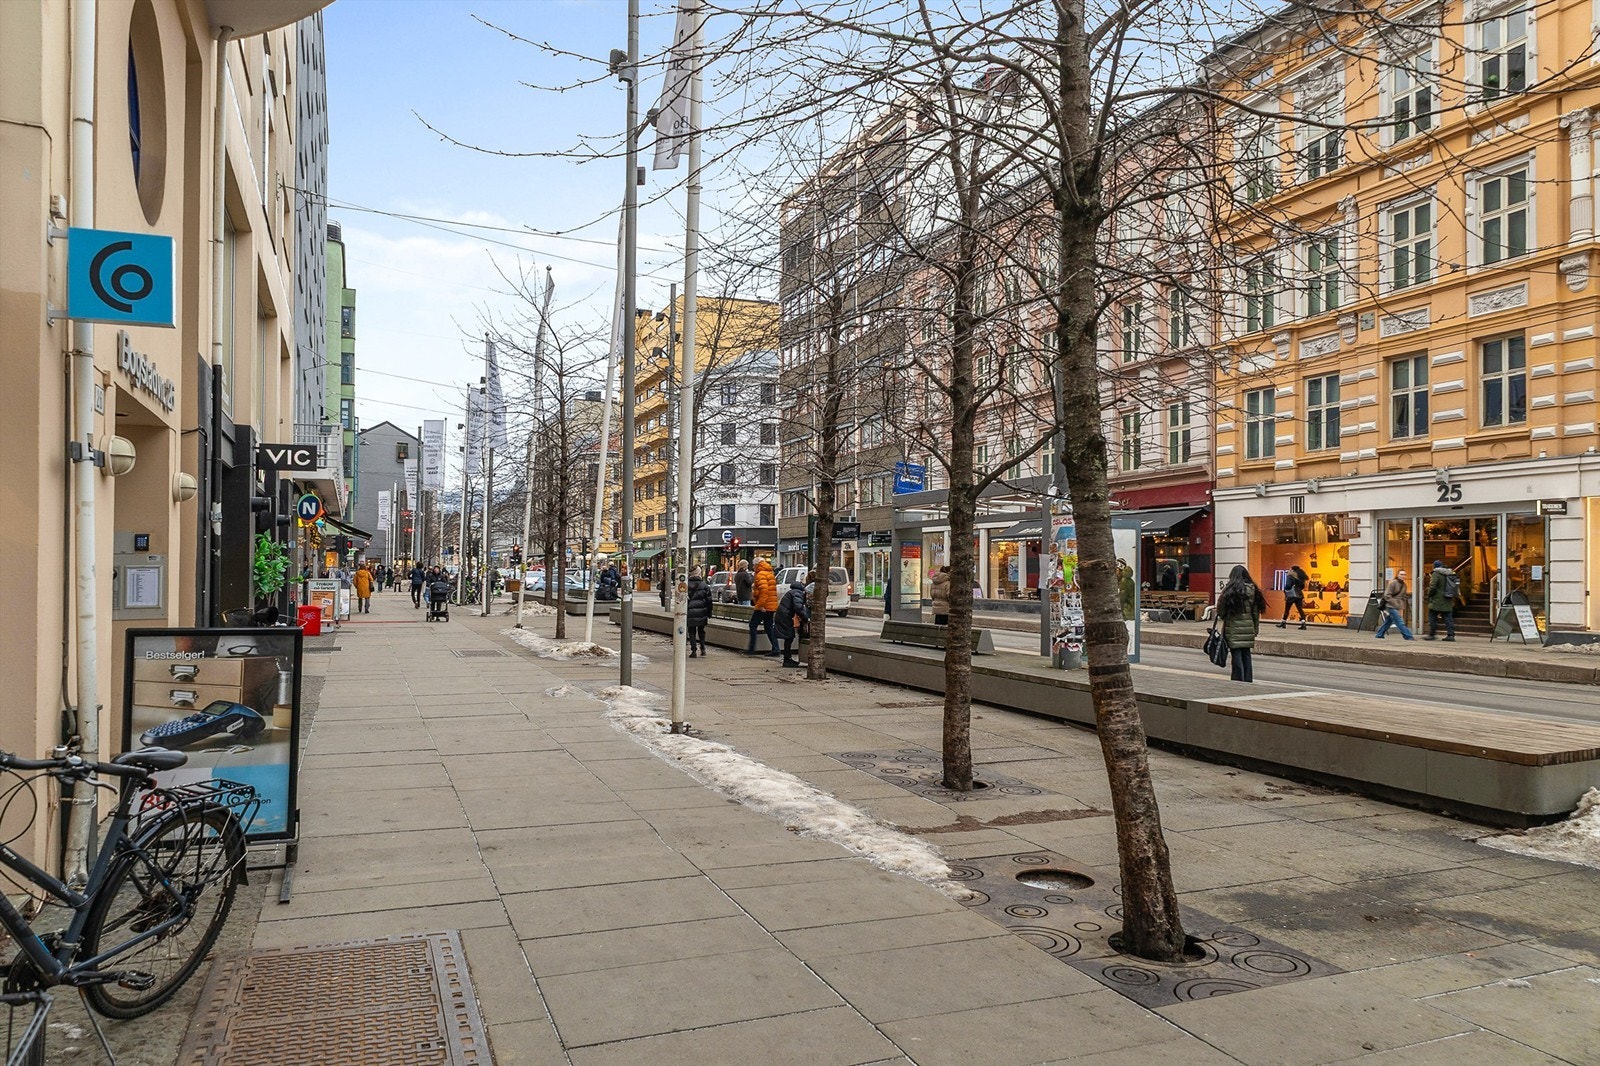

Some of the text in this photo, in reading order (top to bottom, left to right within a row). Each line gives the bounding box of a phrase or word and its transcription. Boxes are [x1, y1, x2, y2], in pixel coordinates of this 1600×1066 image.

[265, 448, 311, 466] VIC
[1436, 484, 1463, 503] 25
[302, 502, 317, 515] N
[145, 650, 205, 661] Bestselger!
